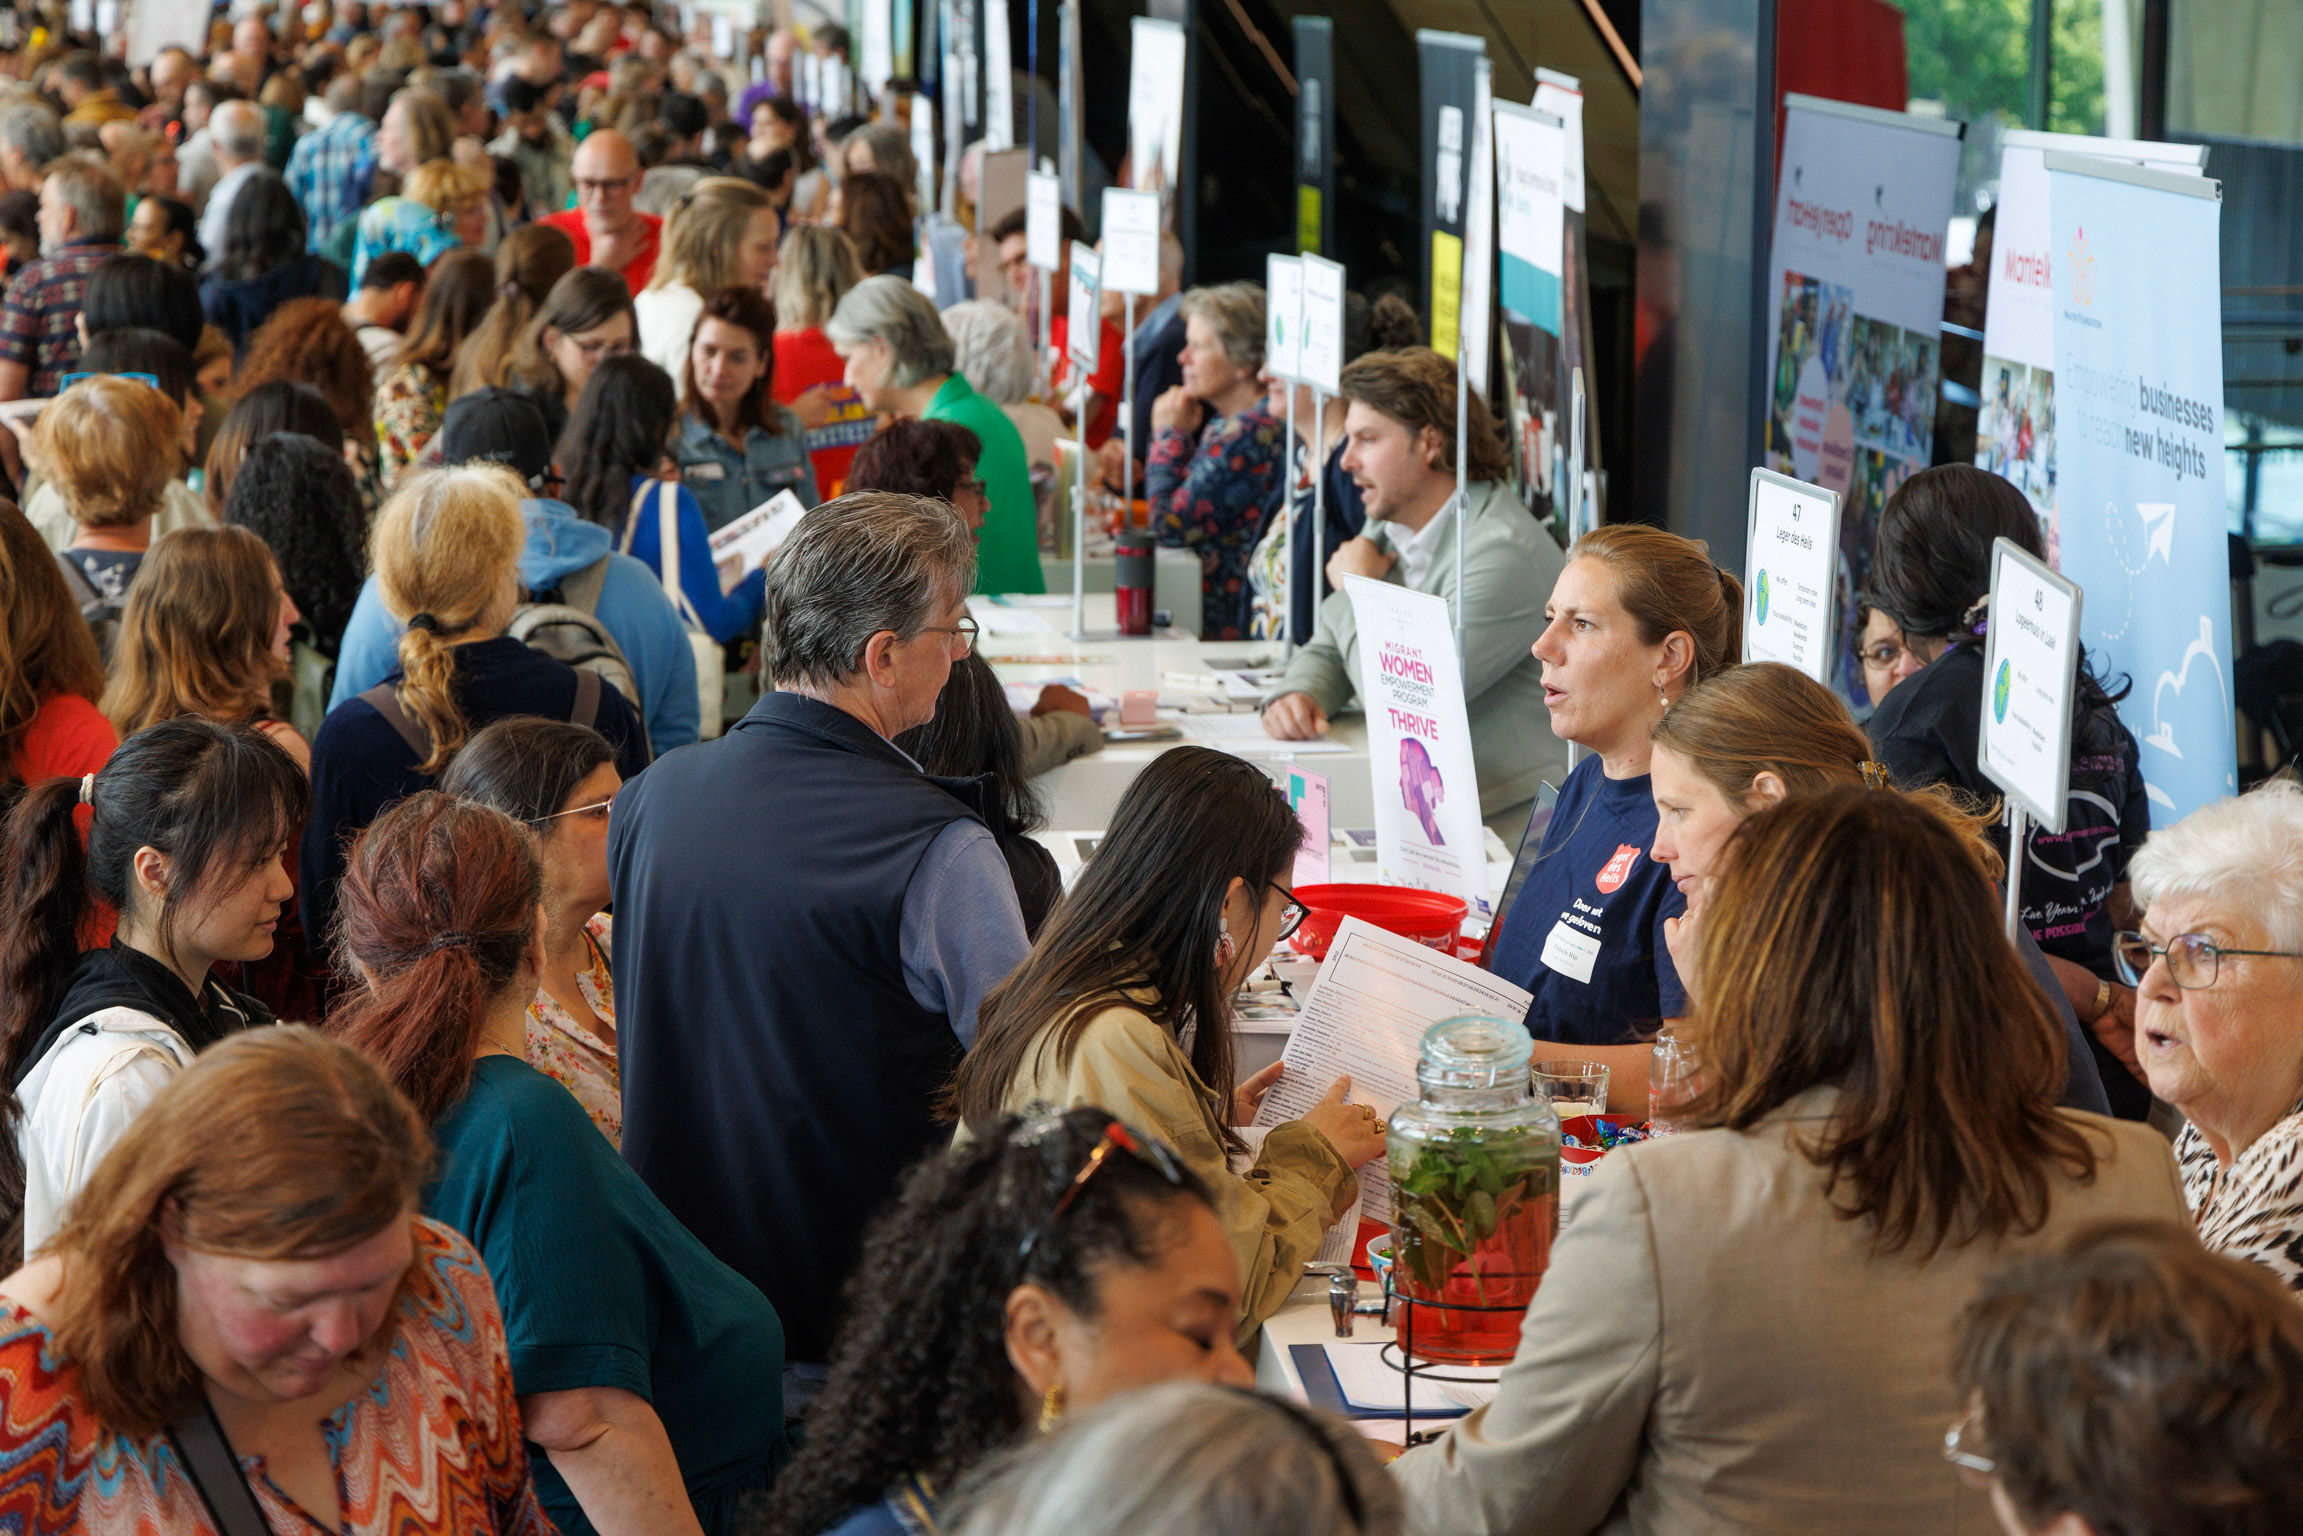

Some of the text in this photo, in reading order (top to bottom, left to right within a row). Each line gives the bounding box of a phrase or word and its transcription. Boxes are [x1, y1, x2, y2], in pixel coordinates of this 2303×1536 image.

[2139, 375, 2214, 434] businesses
[2125, 426, 2153, 460] new
[2157, 427, 2206, 481] heights
[1792, 503, 1802, 522] 47
[1776, 526, 1813, 550] Leger des Heils
[2034, 589, 2043, 612] 48
[1385, 640, 1423, 658] MIGRANT
[1379, 650, 1434, 685] WOMEN
[1381, 673, 1435, 698] EMPOWERMENT
[1392, 688, 1428, 708] PROGRAM
[1388, 708, 1439, 740] THRIVE
[1599, 872, 1620, 884] Heils
[1607, 861, 1622, 872] des
[1568, 912, 1602, 935] geloven
